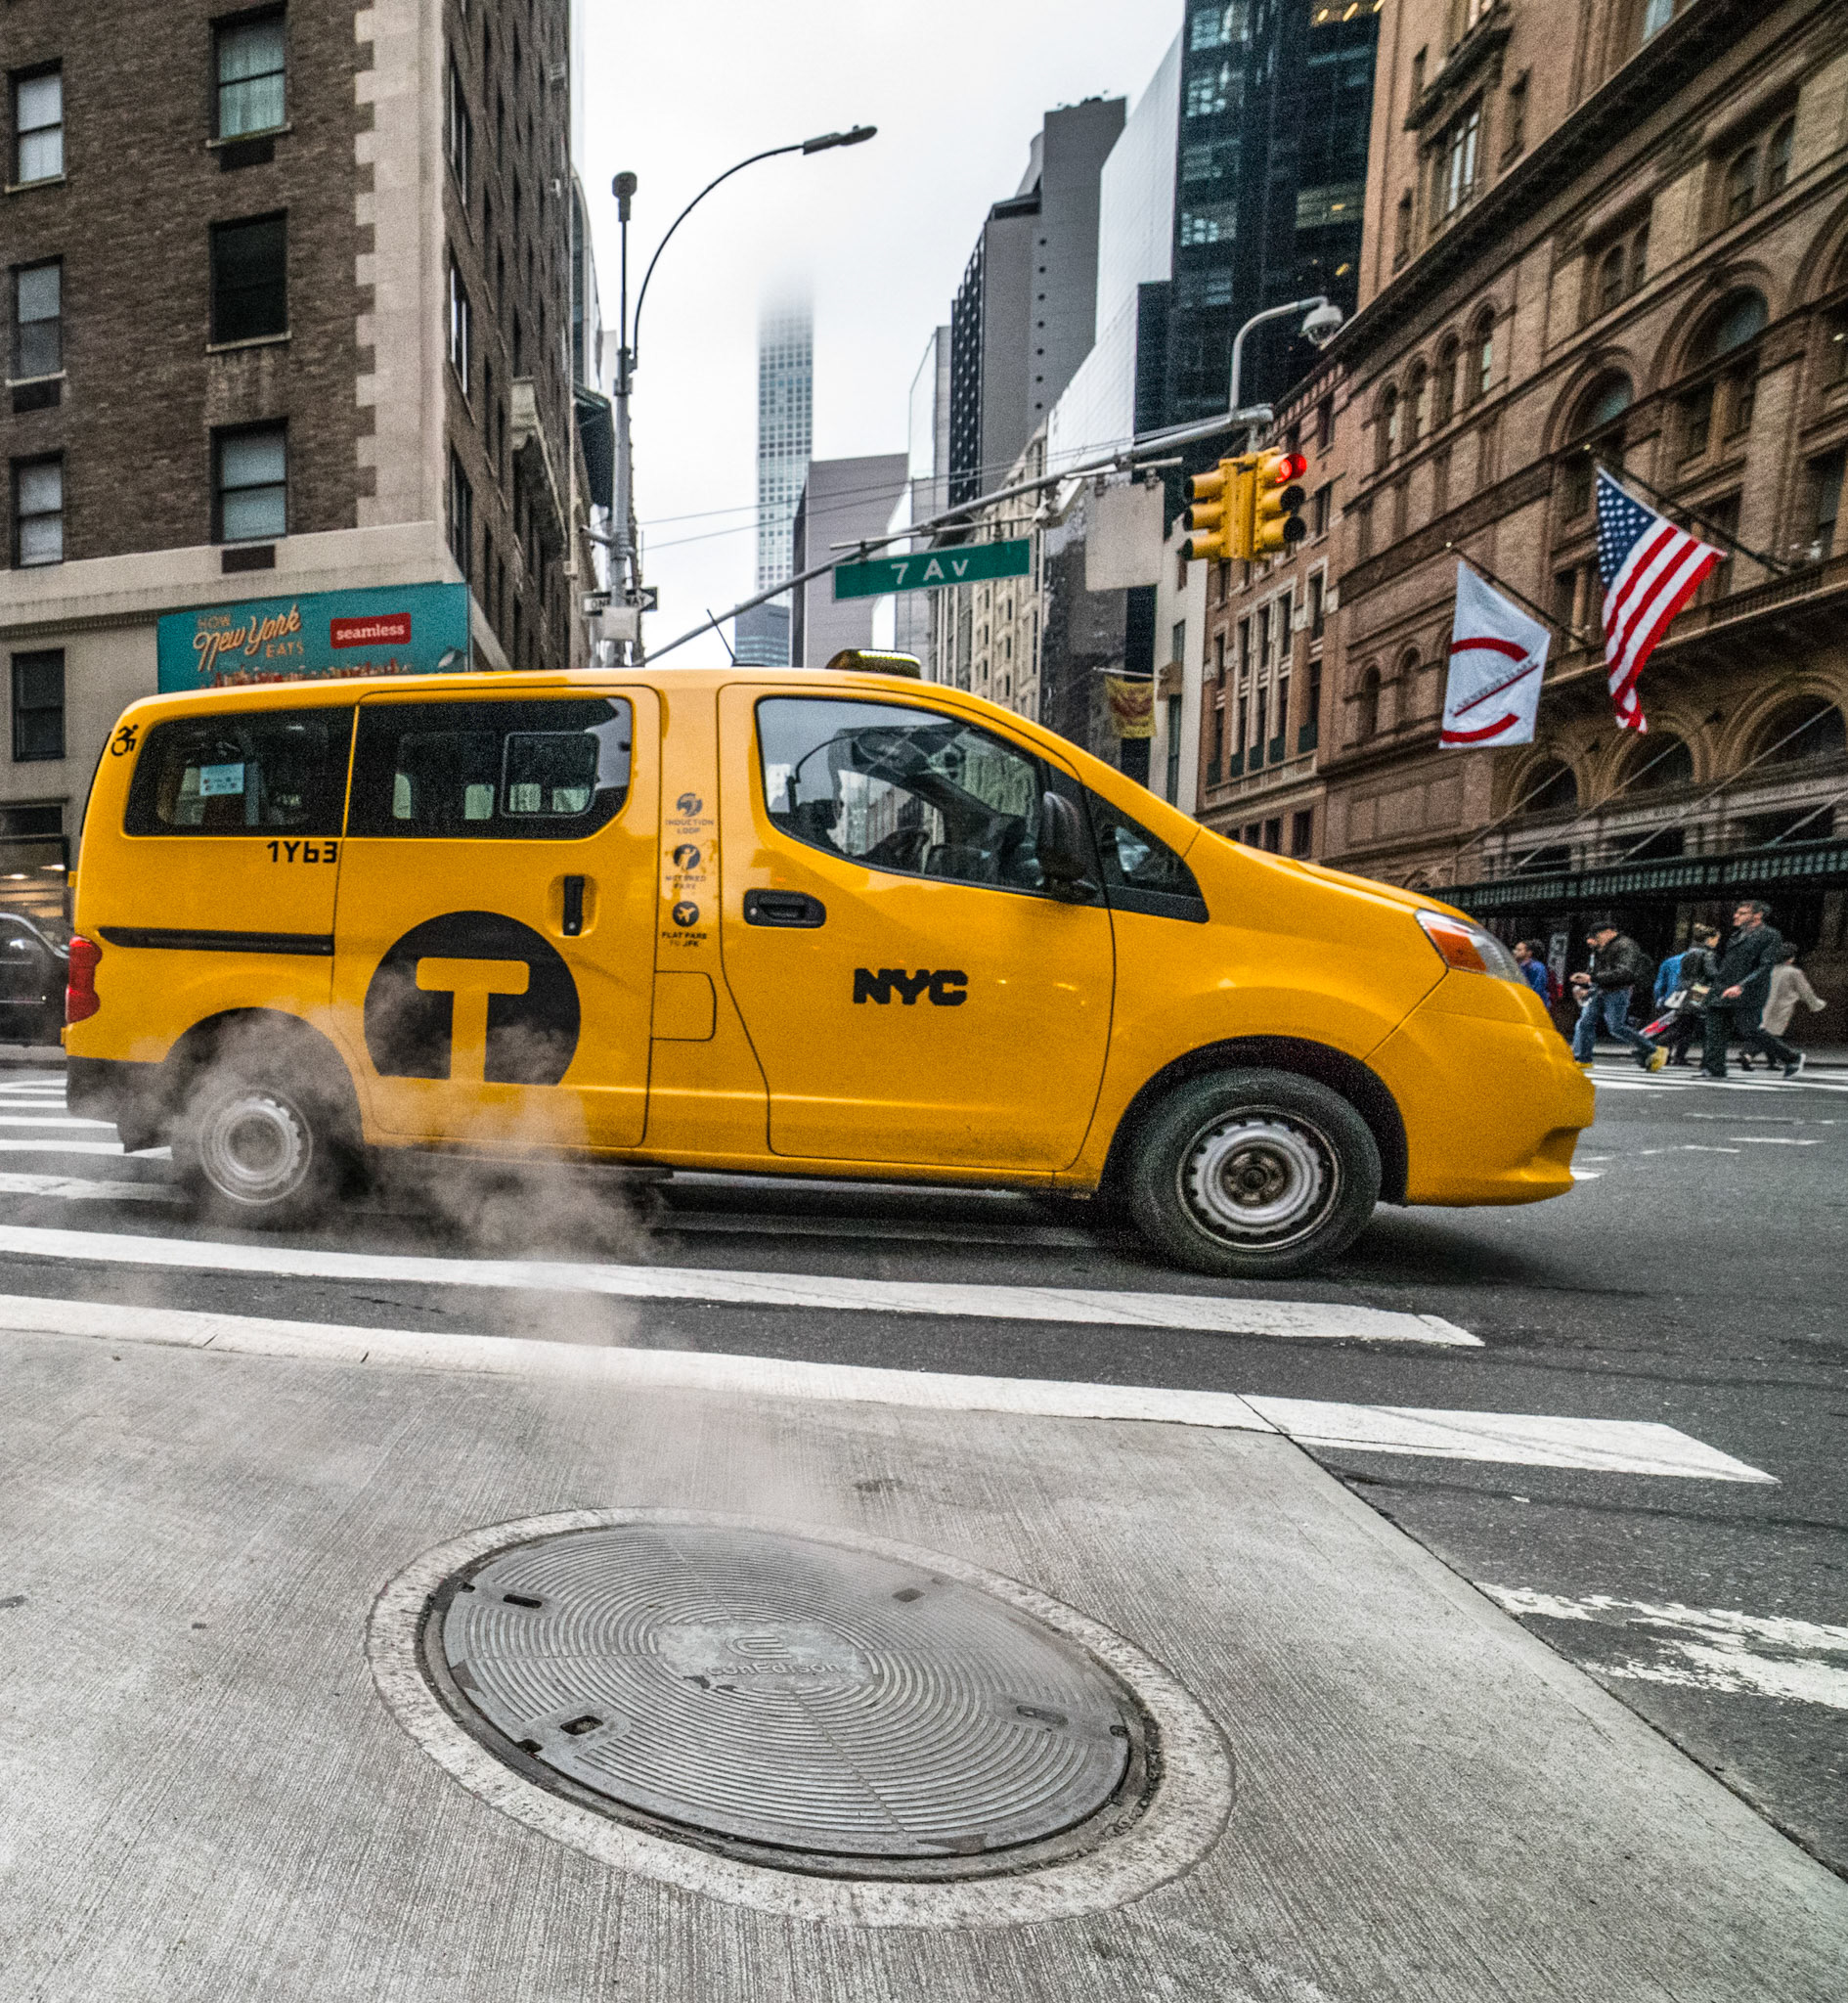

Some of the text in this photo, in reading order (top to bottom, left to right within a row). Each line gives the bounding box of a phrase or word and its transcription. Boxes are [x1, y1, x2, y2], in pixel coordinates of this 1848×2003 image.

[890, 561, 909, 585] 7
[198, 613, 231, 629] HOW
[336, 624, 406, 641] seamless
[193, 602, 301, 673] New York
[266, 642, 304, 658] EATS
[267, 840, 338, 863] 1Y63
[853, 968, 969, 1006] NYC
